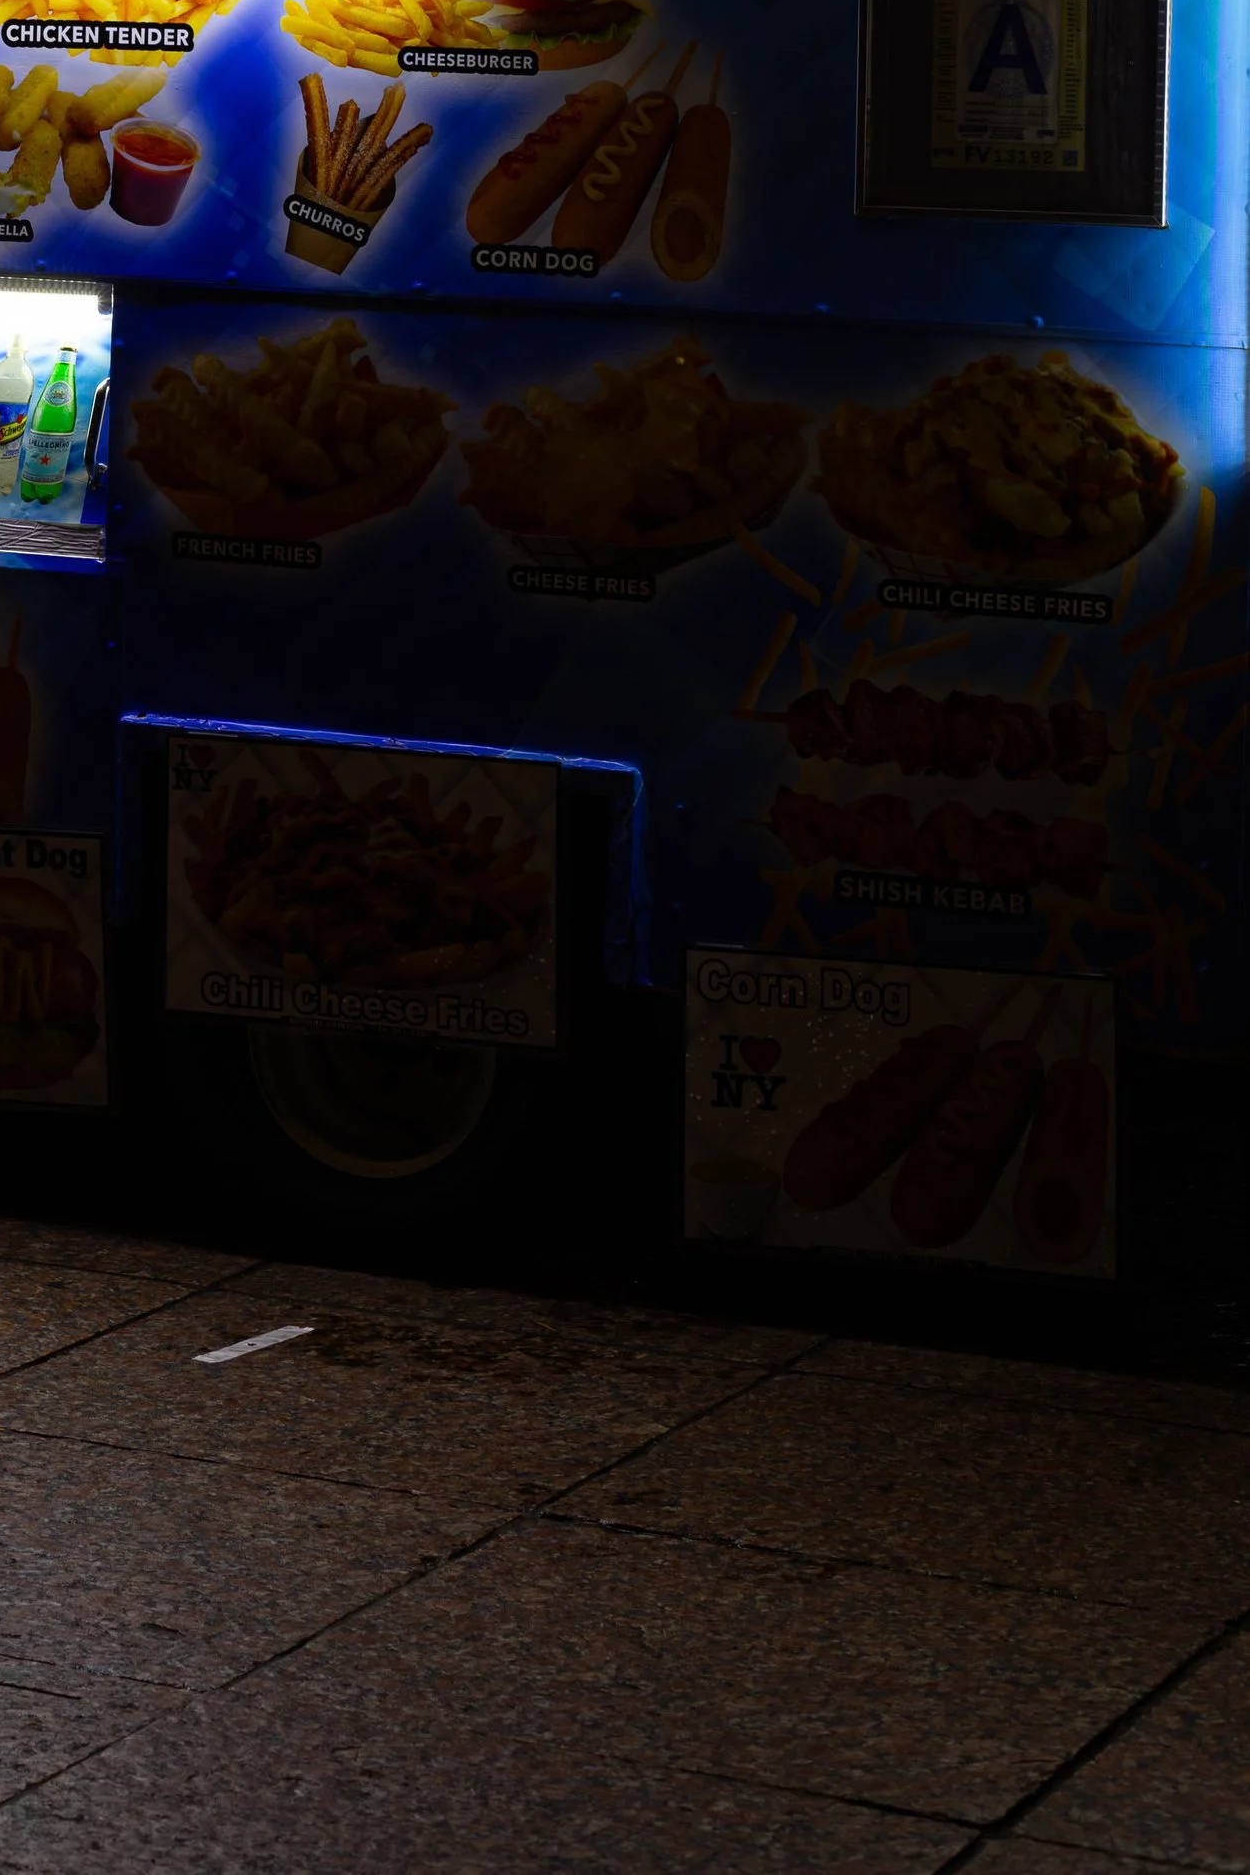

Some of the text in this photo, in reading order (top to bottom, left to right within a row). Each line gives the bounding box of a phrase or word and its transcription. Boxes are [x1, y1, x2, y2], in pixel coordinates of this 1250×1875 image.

[5, 24, 190, 48] CHICKEN TENDER
[968, 3, 1048, 95] A
[402, 51, 534, 72] CHEESEBURGER
[287, 200, 366, 243] CHURROS
[475, 249, 595, 272] CORN DOG
[175, 535, 318, 565] FRENCH FRIES
[512, 569, 651, 597] CHEESE FRIES
[882, 583, 1107, 621] CHILI CHEESE FRIES
[26, 839, 88, 878] Dog
[839, 877, 1027, 916] SHISH KEBAB
[201, 971, 284, 1012] Chili
[292, 980, 427, 1026] Cheese
[436, 992, 530, 1038] Fries
[696, 958, 911, 1027] Corn Dog
[712, 1072, 786, 1110] NY
